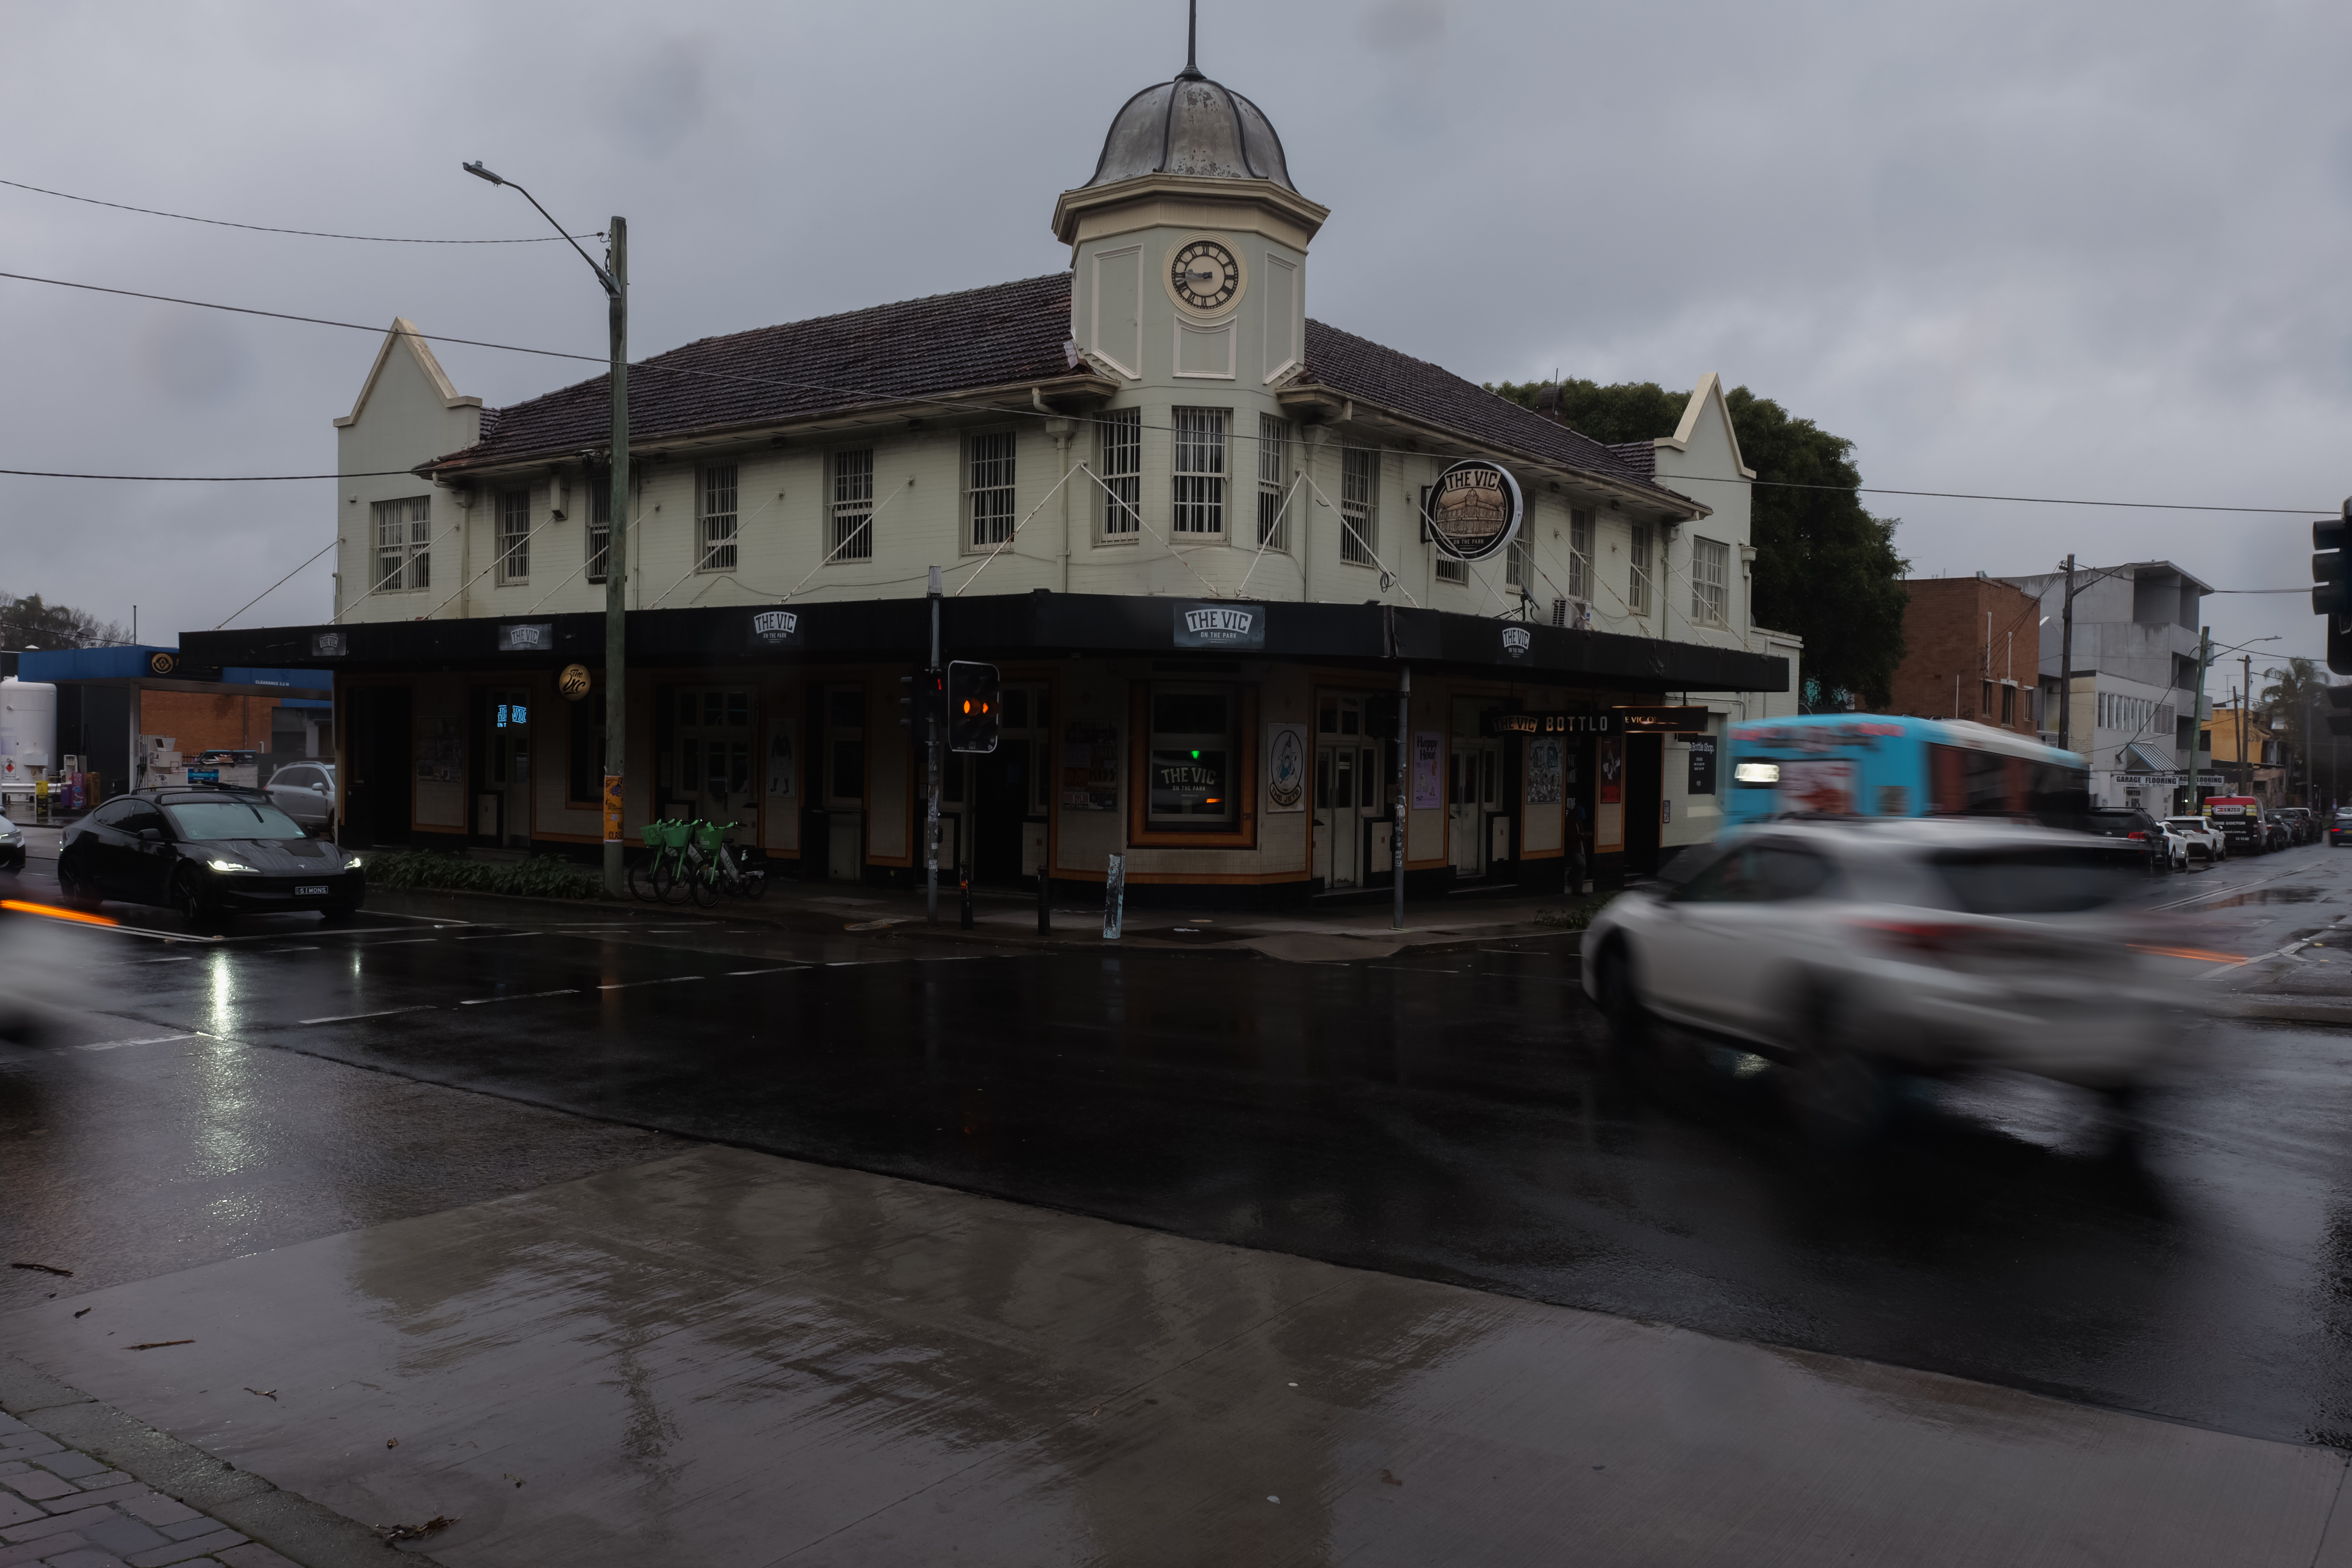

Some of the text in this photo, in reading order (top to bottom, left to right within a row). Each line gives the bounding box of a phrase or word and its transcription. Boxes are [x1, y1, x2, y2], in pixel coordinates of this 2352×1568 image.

[1446, 471, 1497, 489] THE VIC
[756, 613, 794, 632] THE VIC
[1188, 611, 1248, 631] THE VIC
[320, 637, 338, 647] THE VIC
[512, 629, 537, 642] THE VIC
[1504, 630, 1528, 647] THE VIC
[1494, 717, 1536, 731] THE VIC
[1546, 716, 1607, 731] BOTTLO
[1417, 736, 1439, 752] Happy
[1692, 742, 1704, 751] Bottle
[1420, 749, 1436, 761] Hour
[1161, 767, 1216, 785] THE VIC
[1065, 794, 1088, 804] BOB DYLAN
[1272, 786, 1299, 802] THE JETS
[724, 855, 735, 872] Lime
